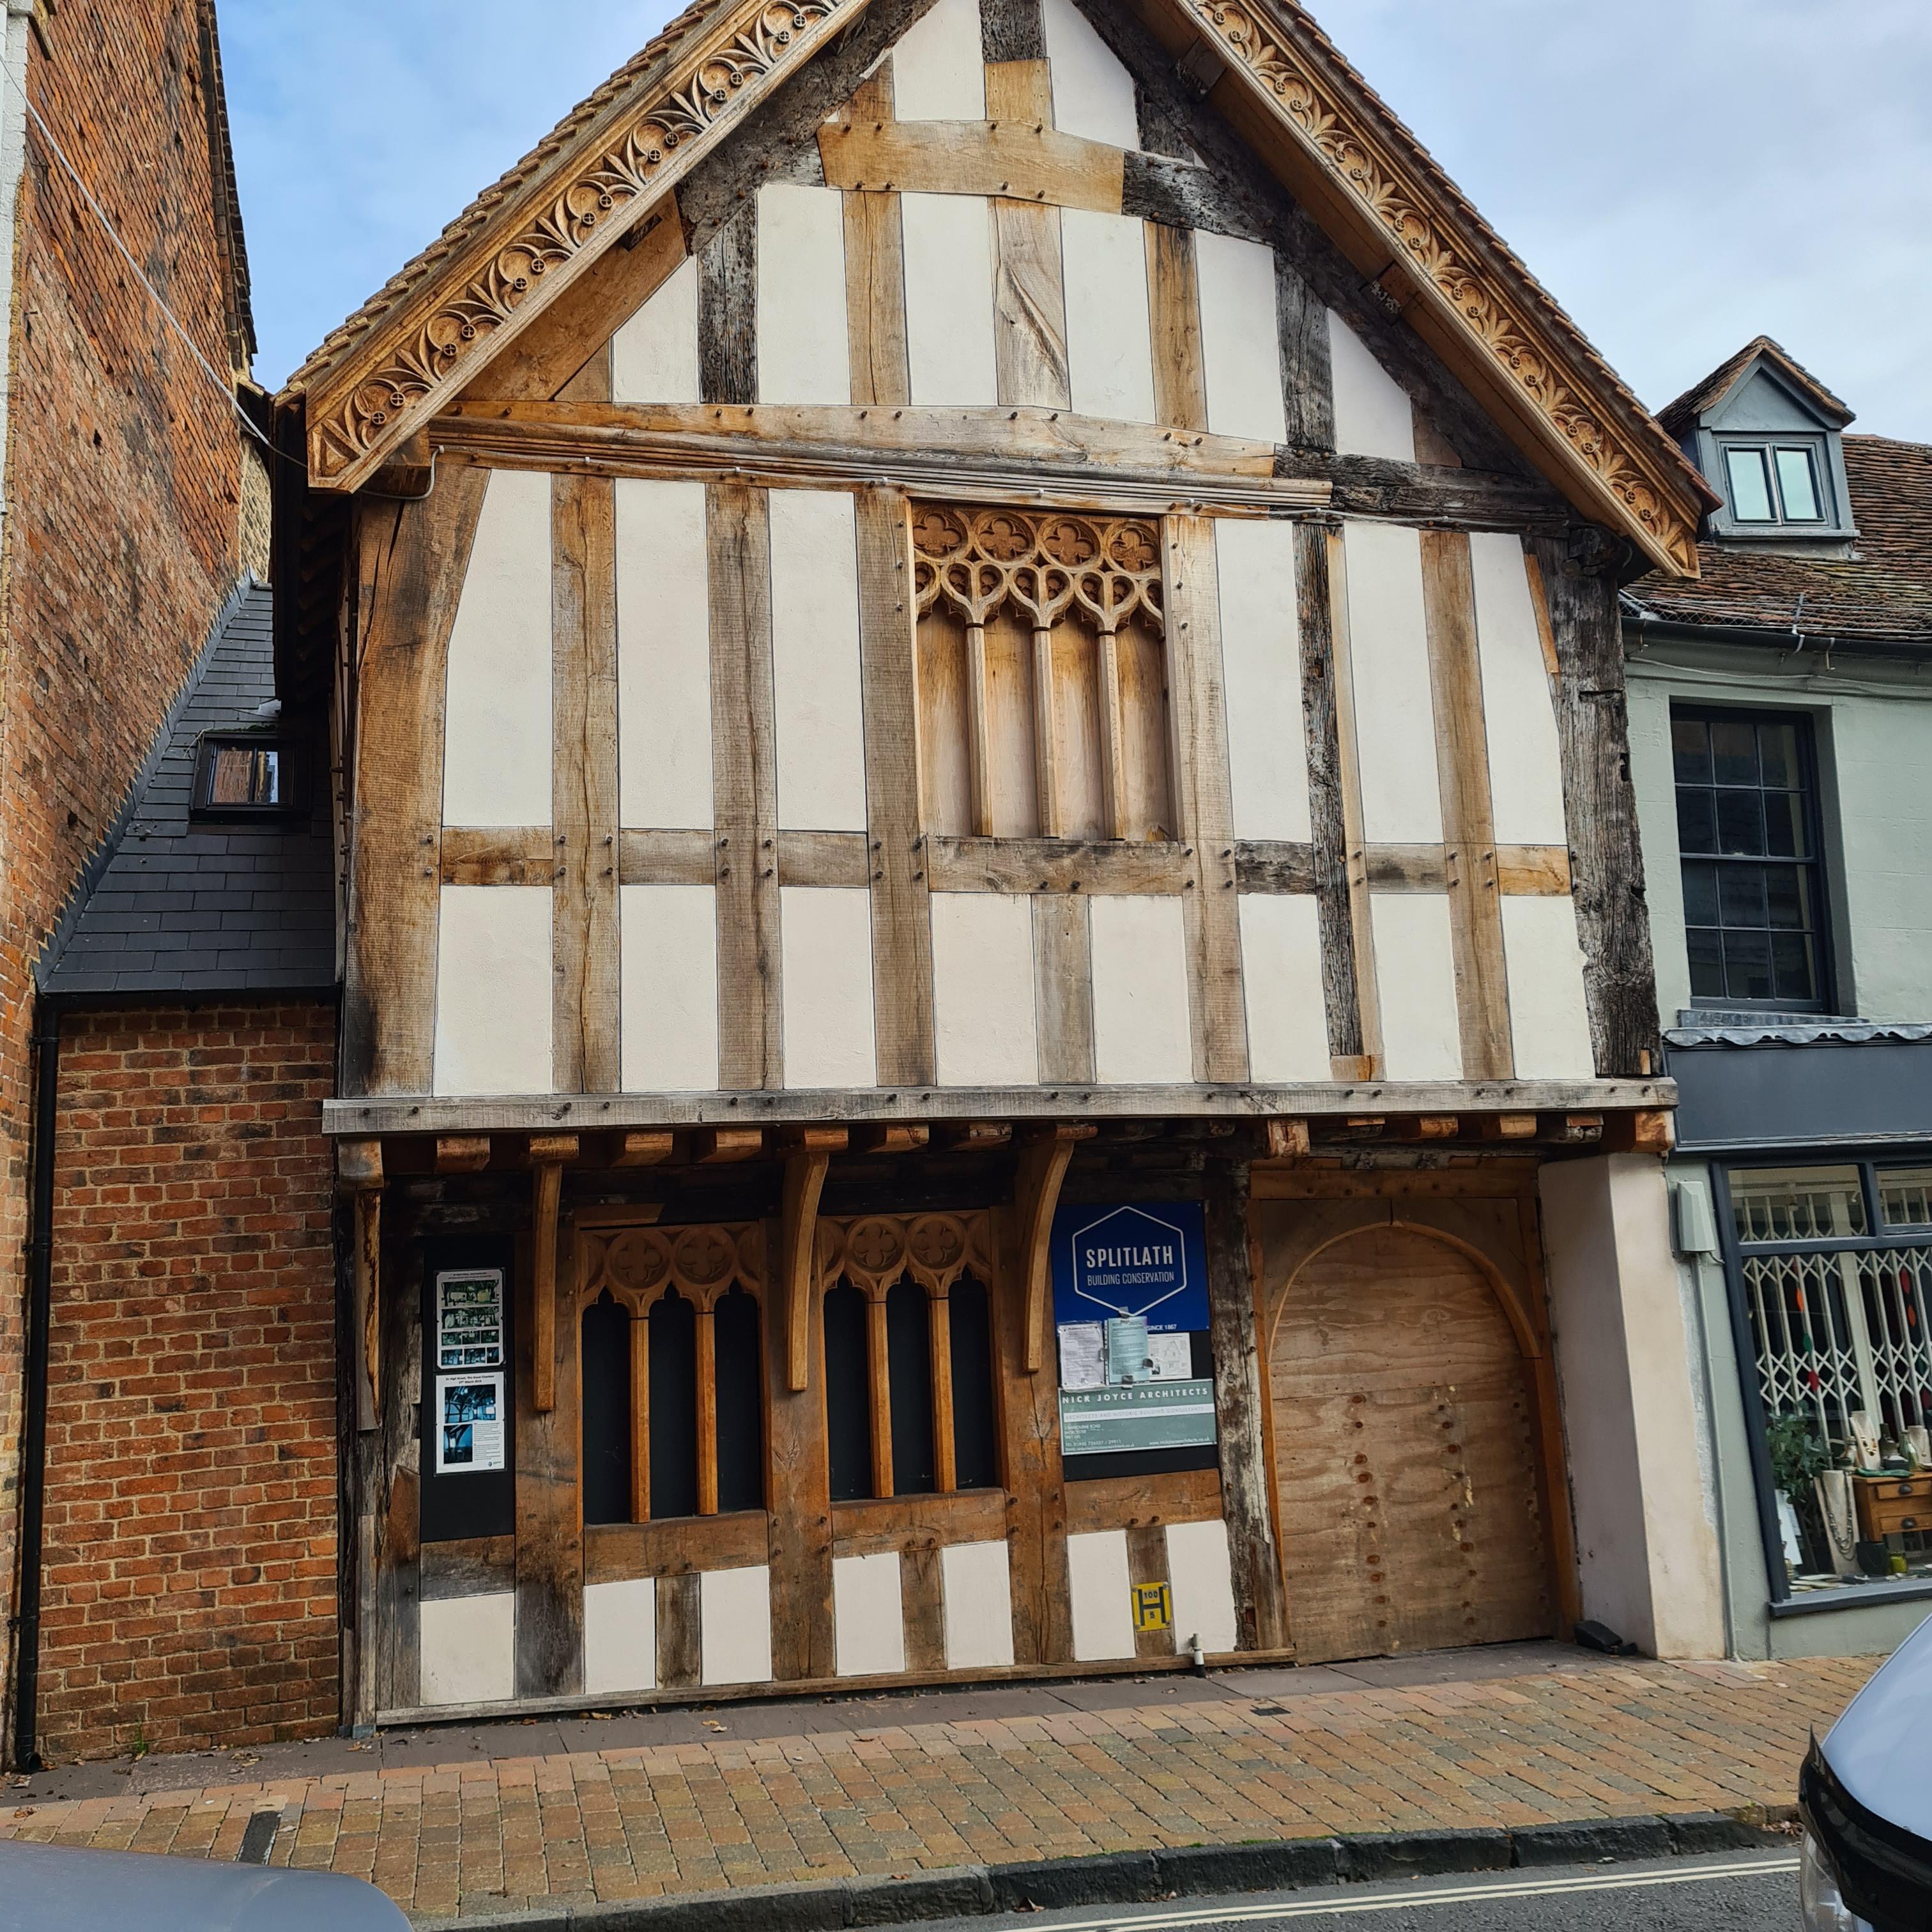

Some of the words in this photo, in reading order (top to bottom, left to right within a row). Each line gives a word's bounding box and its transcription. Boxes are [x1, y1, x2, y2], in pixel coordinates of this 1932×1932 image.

[1087, 1246, 1173, 1268] SPLITLATH
[1087, 1274, 1120, 1286] BUILDING
[1123, 1271, 1174, 1284] CONSERVATION
[1062, 1395, 1091, 1404] NICK
[1097, 1393, 1133, 1402] JOYCE
[1139, 1388, 1208, 1399] ARCHITECTS
[1144, 1590, 1158, 1598] 100
[1138, 1586, 1167, 1626] H
